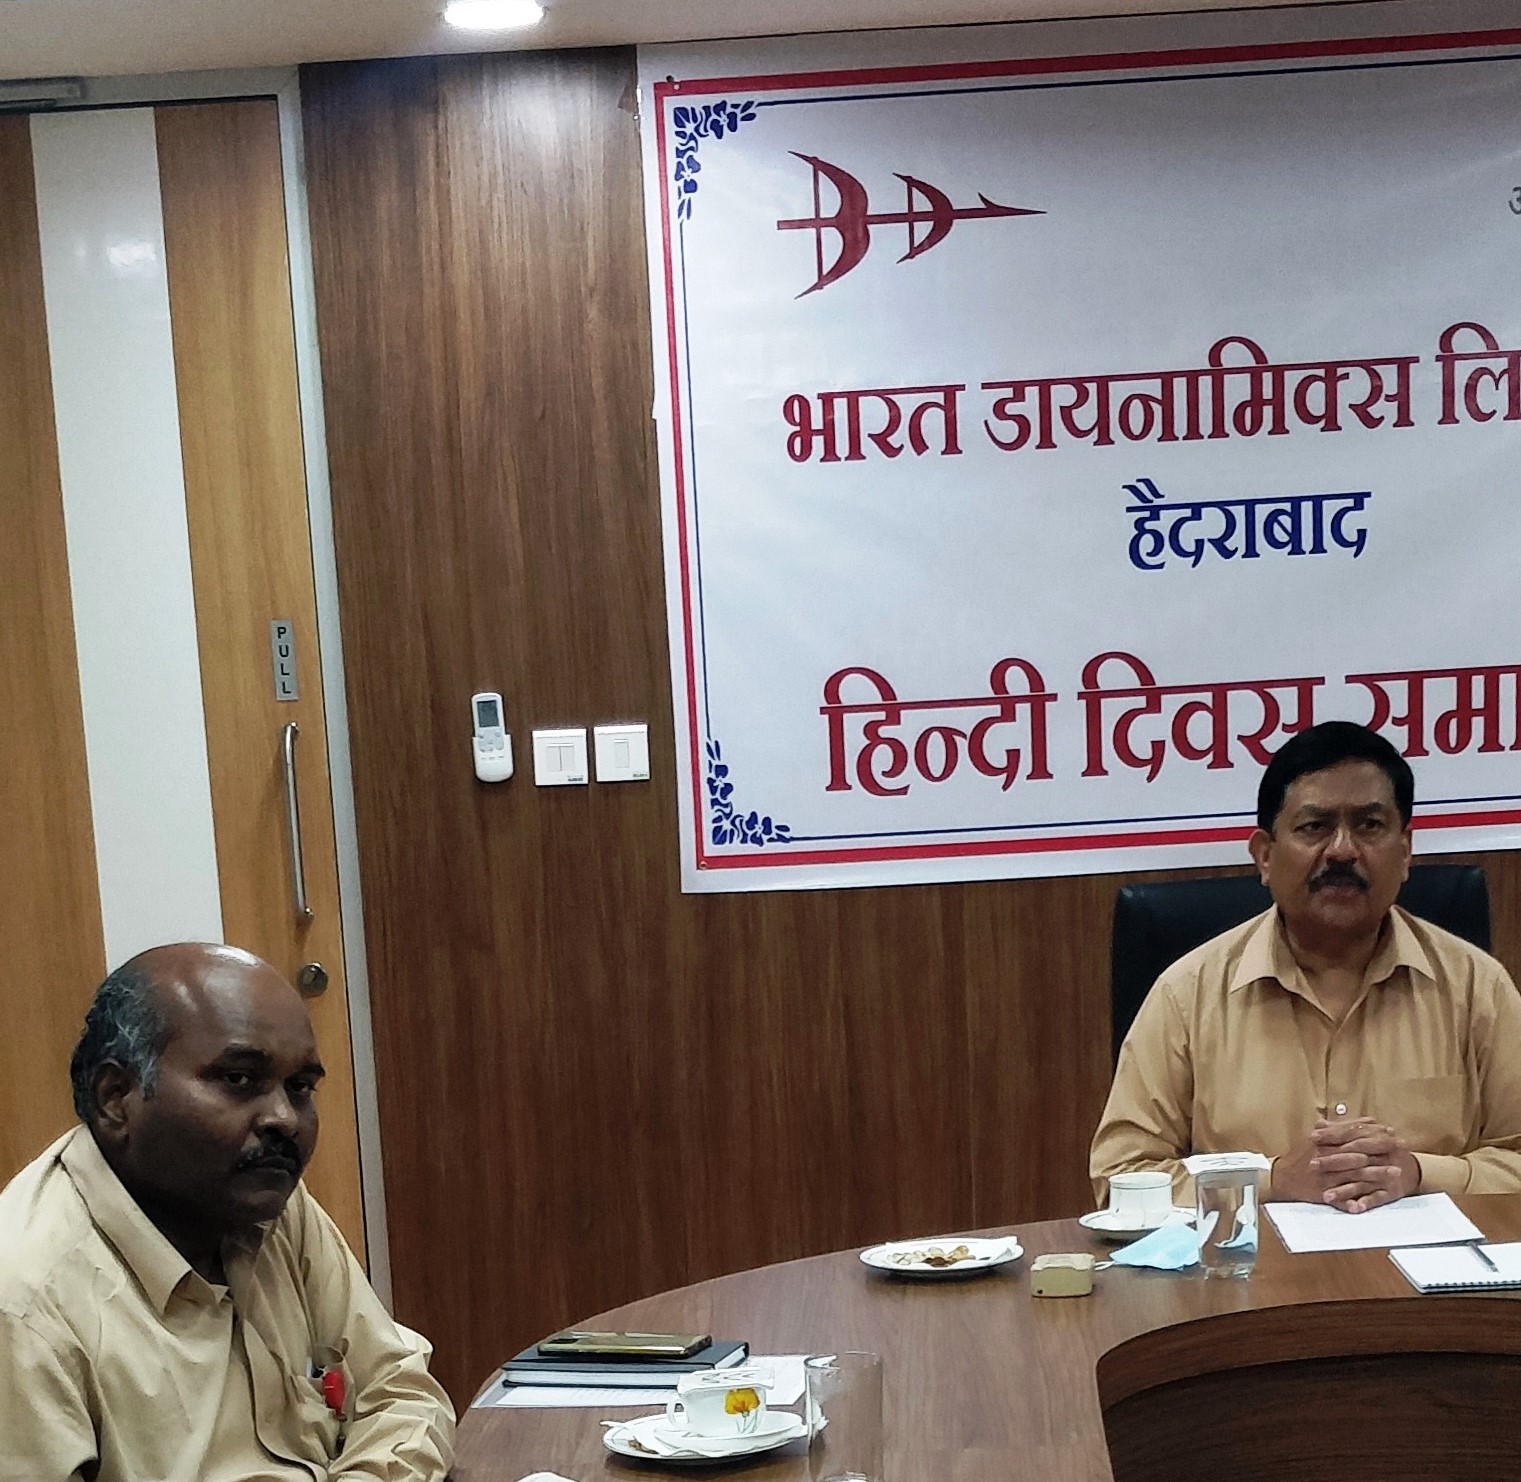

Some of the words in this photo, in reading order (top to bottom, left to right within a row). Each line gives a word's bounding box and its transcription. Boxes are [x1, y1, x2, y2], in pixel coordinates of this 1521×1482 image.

[784, 384, 966, 464] भारत
[981, 335, 1420, 450] डायनामिक्स
[1123, 478, 1372, 570] हैदराबाद
[819, 657, 1058, 796] हिन्दी
[1078, 651, 1325, 783] दिवस
